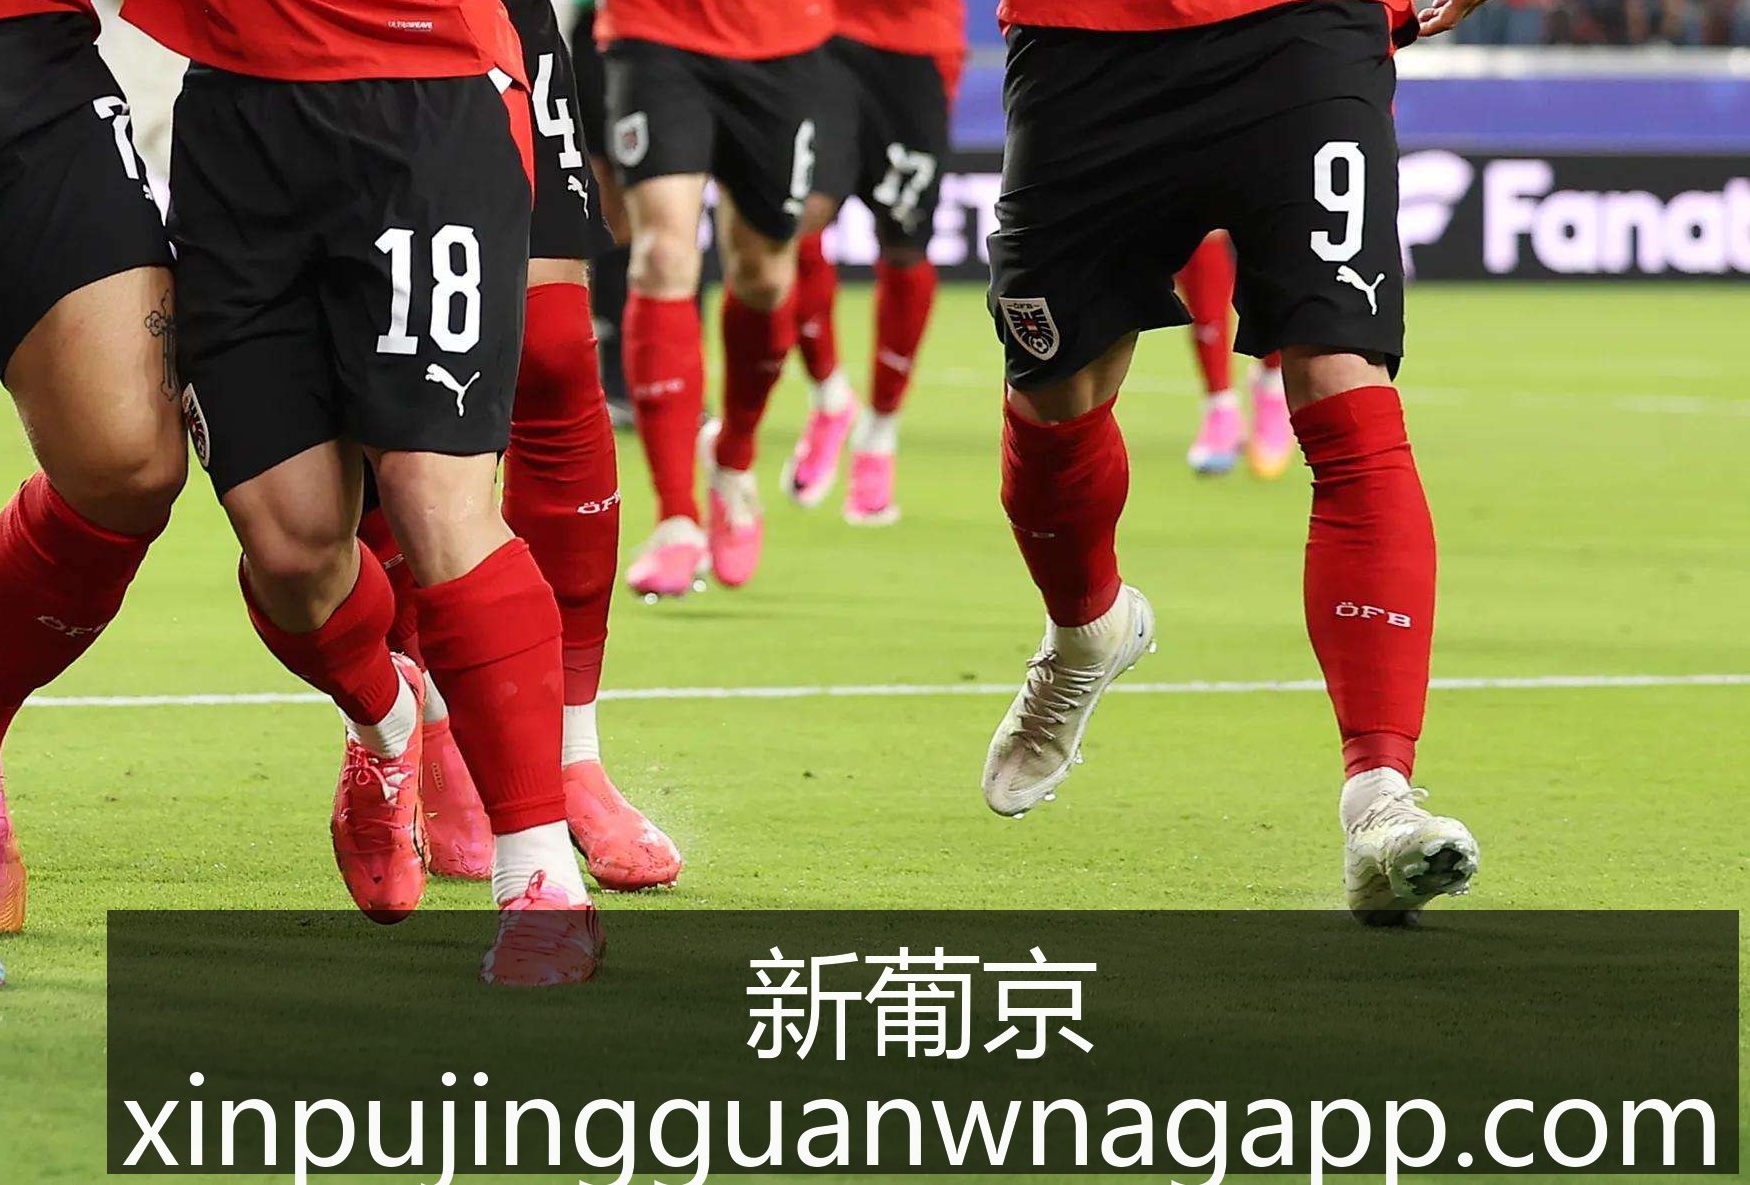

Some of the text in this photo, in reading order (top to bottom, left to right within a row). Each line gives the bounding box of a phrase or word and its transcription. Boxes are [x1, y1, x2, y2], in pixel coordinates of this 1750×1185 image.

[93, 95, 140, 180] 7
[532, 53, 583, 169] 4
[1310, 141, 1365, 262] 9
[374, 224, 481, 355] 18
[1335, 601, 1411, 628] ÖFB
